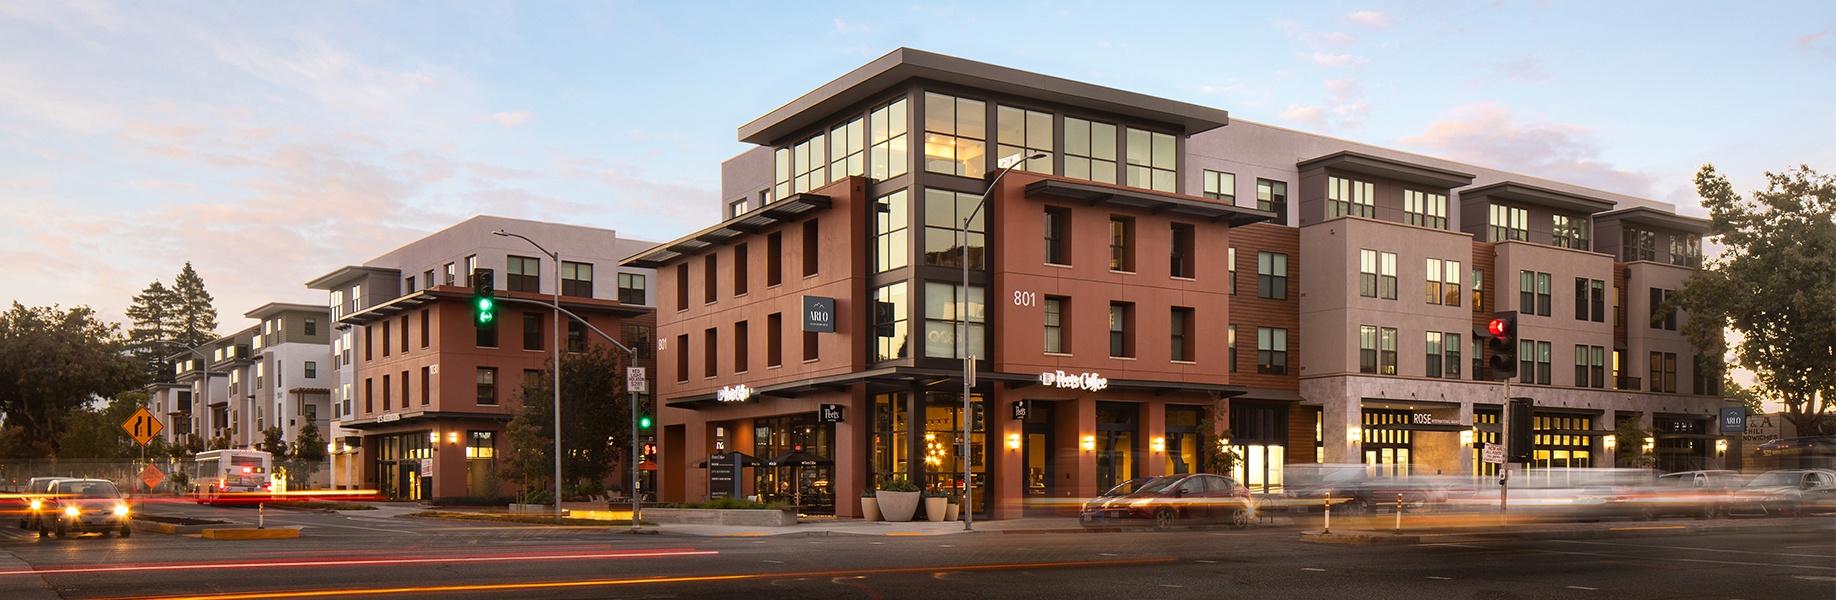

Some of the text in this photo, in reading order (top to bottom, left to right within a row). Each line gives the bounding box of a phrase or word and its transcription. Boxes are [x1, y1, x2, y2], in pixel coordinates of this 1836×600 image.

[1013, 290, 1036, 307] 801
[809, 311, 829, 322] ARLO
[658, 338, 667, 350] 801
[1080, 372, 1108, 392] Coffee
[1413, 413, 1432, 425] ROSE
[1750, 417, 1774, 428] & A
